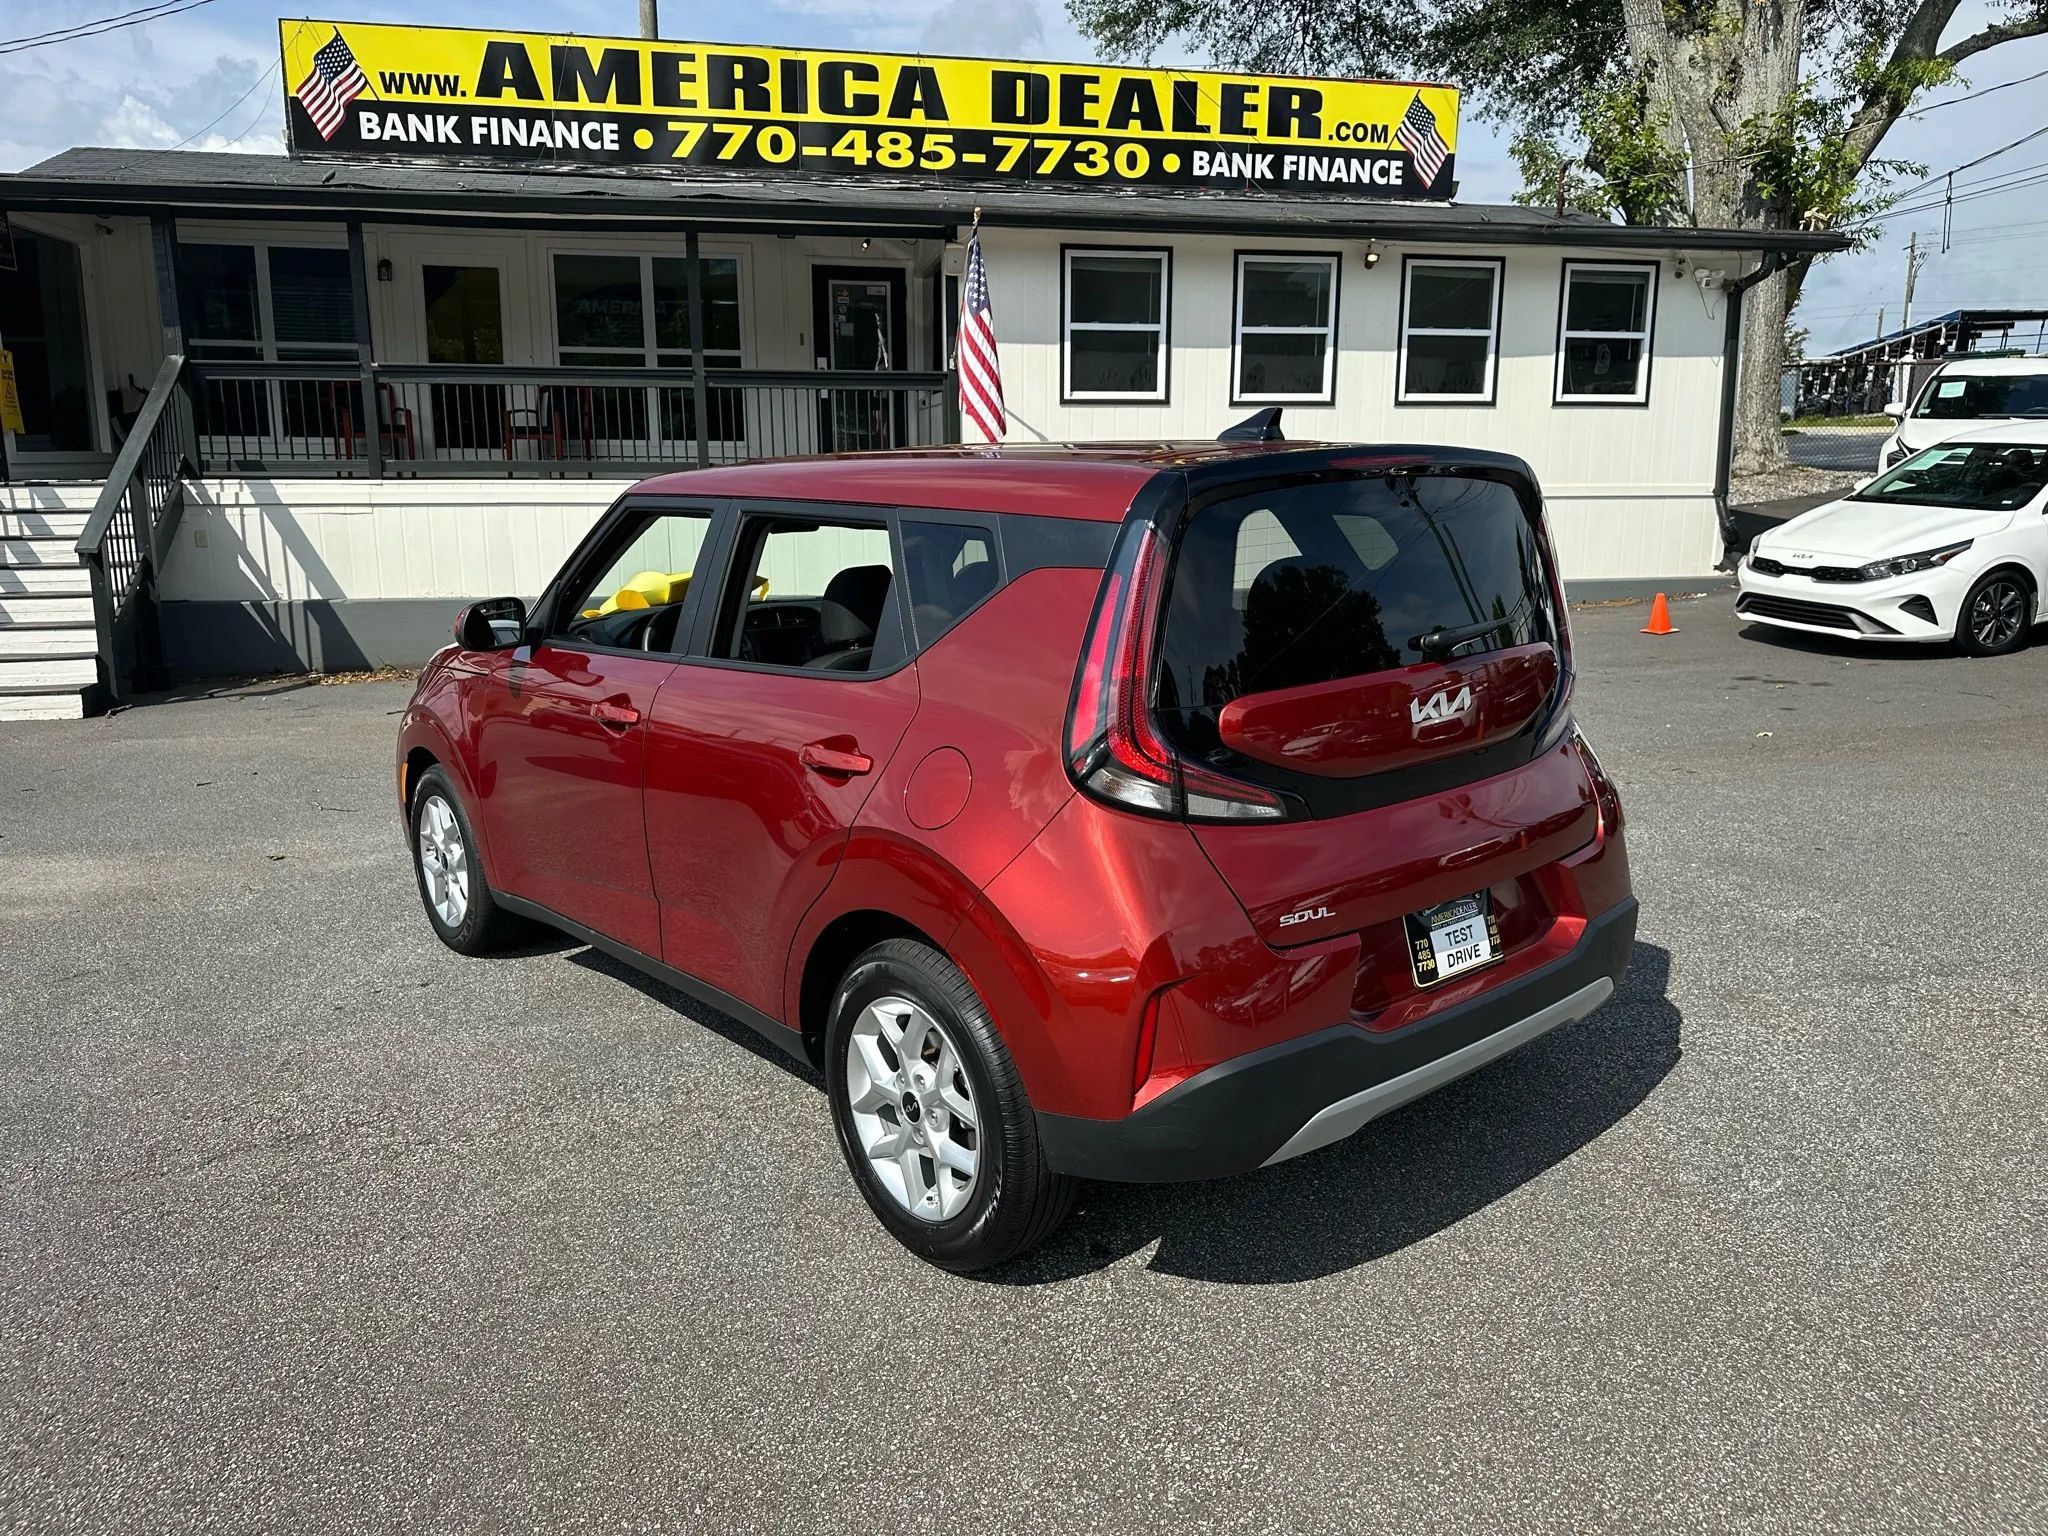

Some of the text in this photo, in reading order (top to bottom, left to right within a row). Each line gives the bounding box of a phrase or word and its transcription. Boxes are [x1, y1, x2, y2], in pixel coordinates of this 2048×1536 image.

[358, 111, 1403, 186] BANK FINANCE 770-485-7730 BANK FINANCE
[1410, 686, 1473, 724] KIA
[1279, 906, 1336, 928] SOUL
[1414, 938, 1429, 951] 770
[1445, 925, 1473, 946] TEST
[1417, 958, 1436, 972] 7730
[1418, 948, 1432, 961] 485
[1447, 944, 1482, 968] DRIVE
